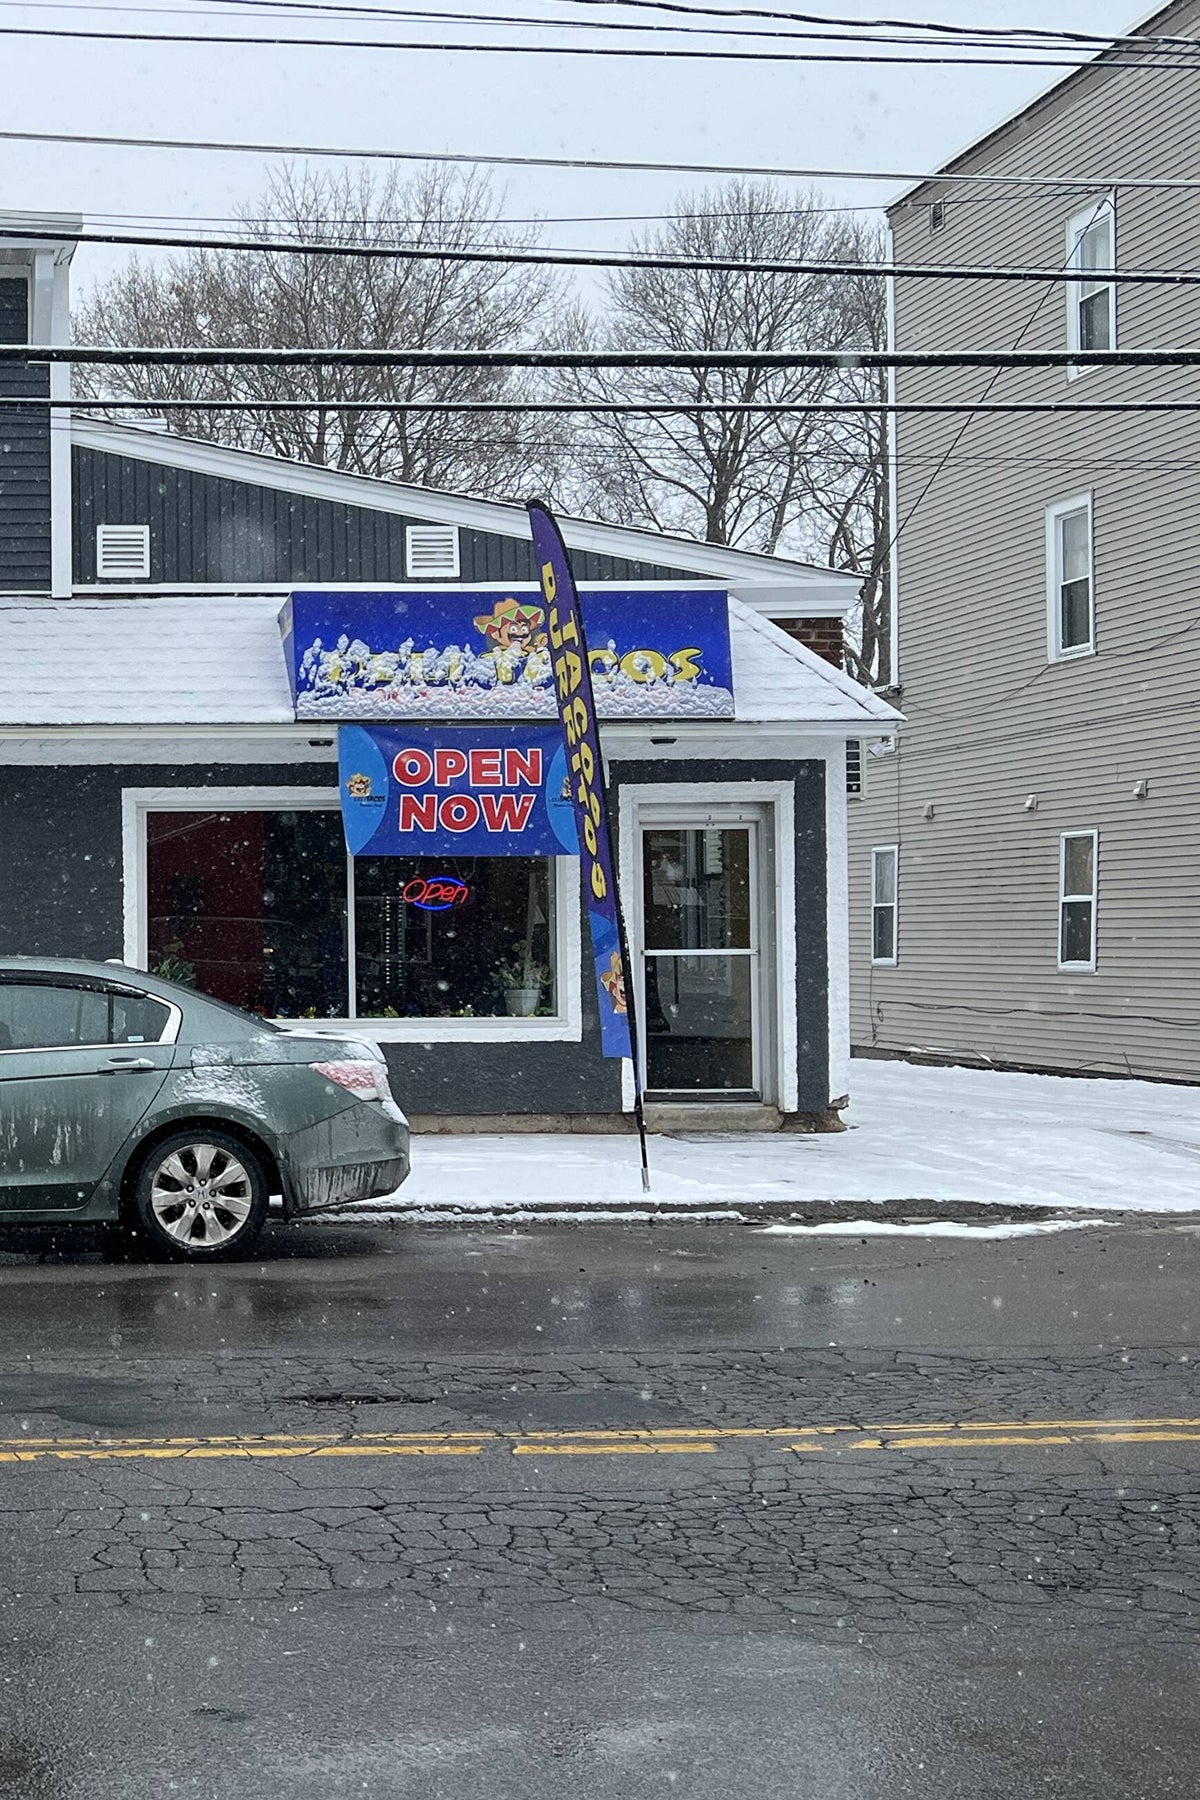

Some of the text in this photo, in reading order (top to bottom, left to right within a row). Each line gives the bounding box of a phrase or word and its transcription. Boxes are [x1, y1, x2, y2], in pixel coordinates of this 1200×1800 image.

[392, 747, 543, 787] OPEN
[398, 793, 537, 833] NOW
[402, 878, 469, 904] Open
